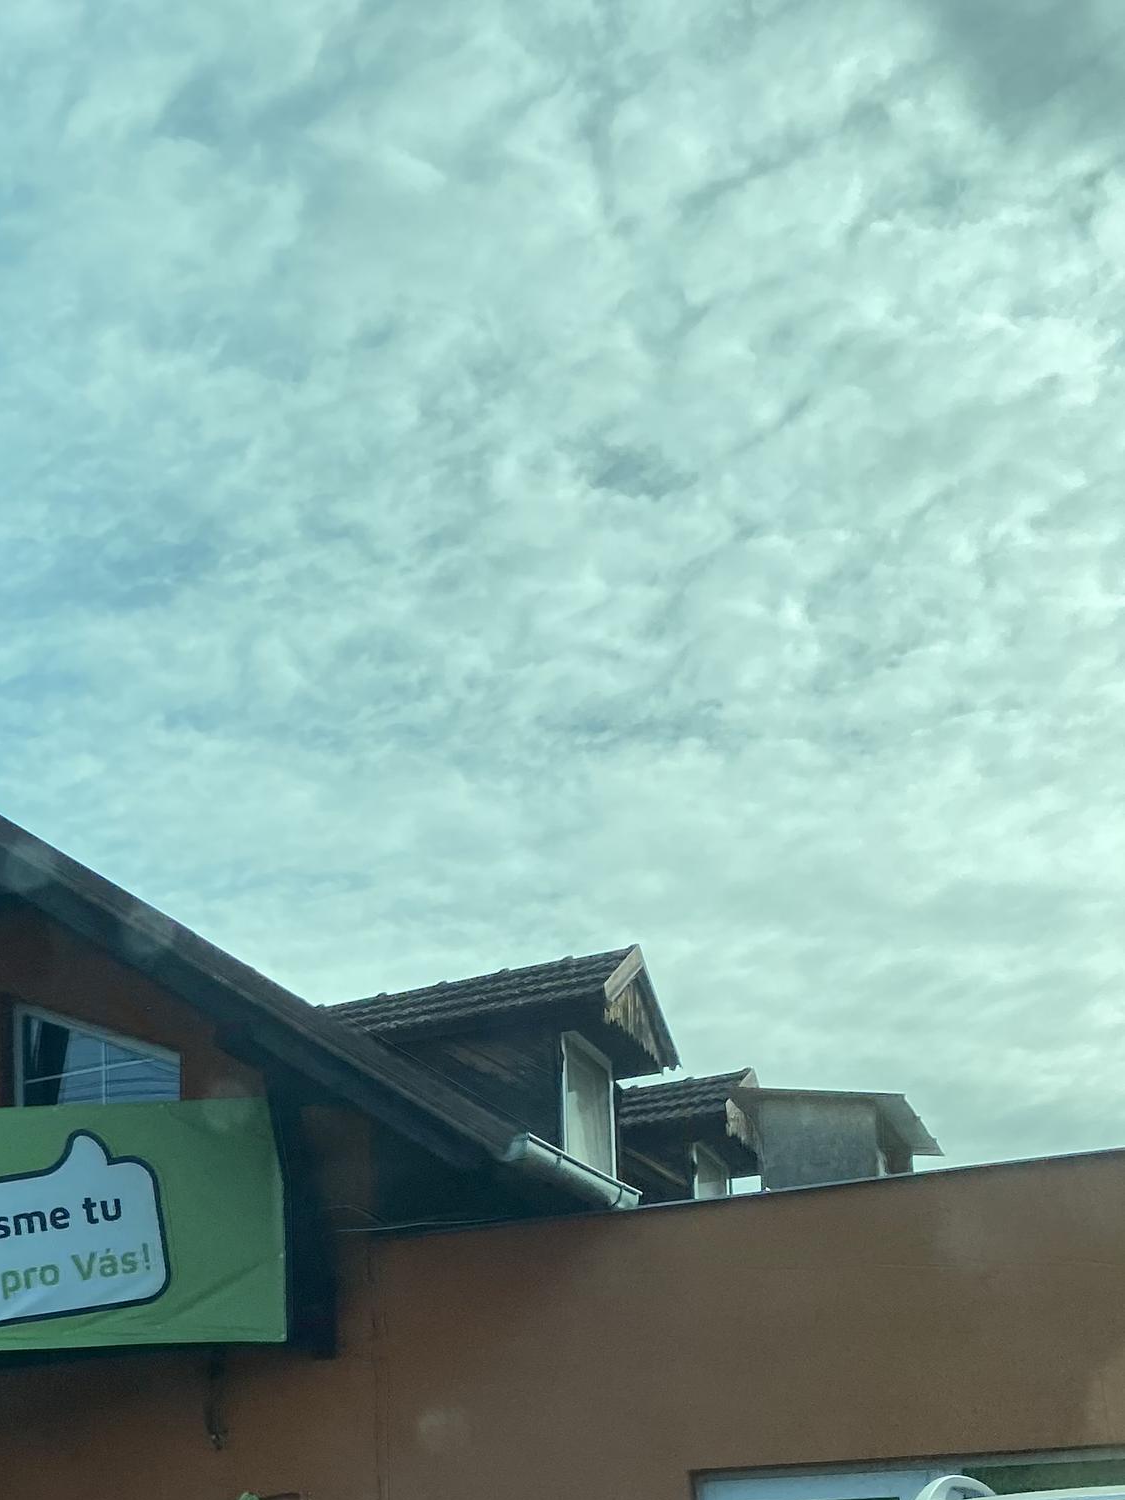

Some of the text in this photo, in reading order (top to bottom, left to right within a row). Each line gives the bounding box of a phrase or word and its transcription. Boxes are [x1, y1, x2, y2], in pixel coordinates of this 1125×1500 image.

[82, 1197, 122, 1224] tu
[0, 1243, 151, 1300] pro Vás!
